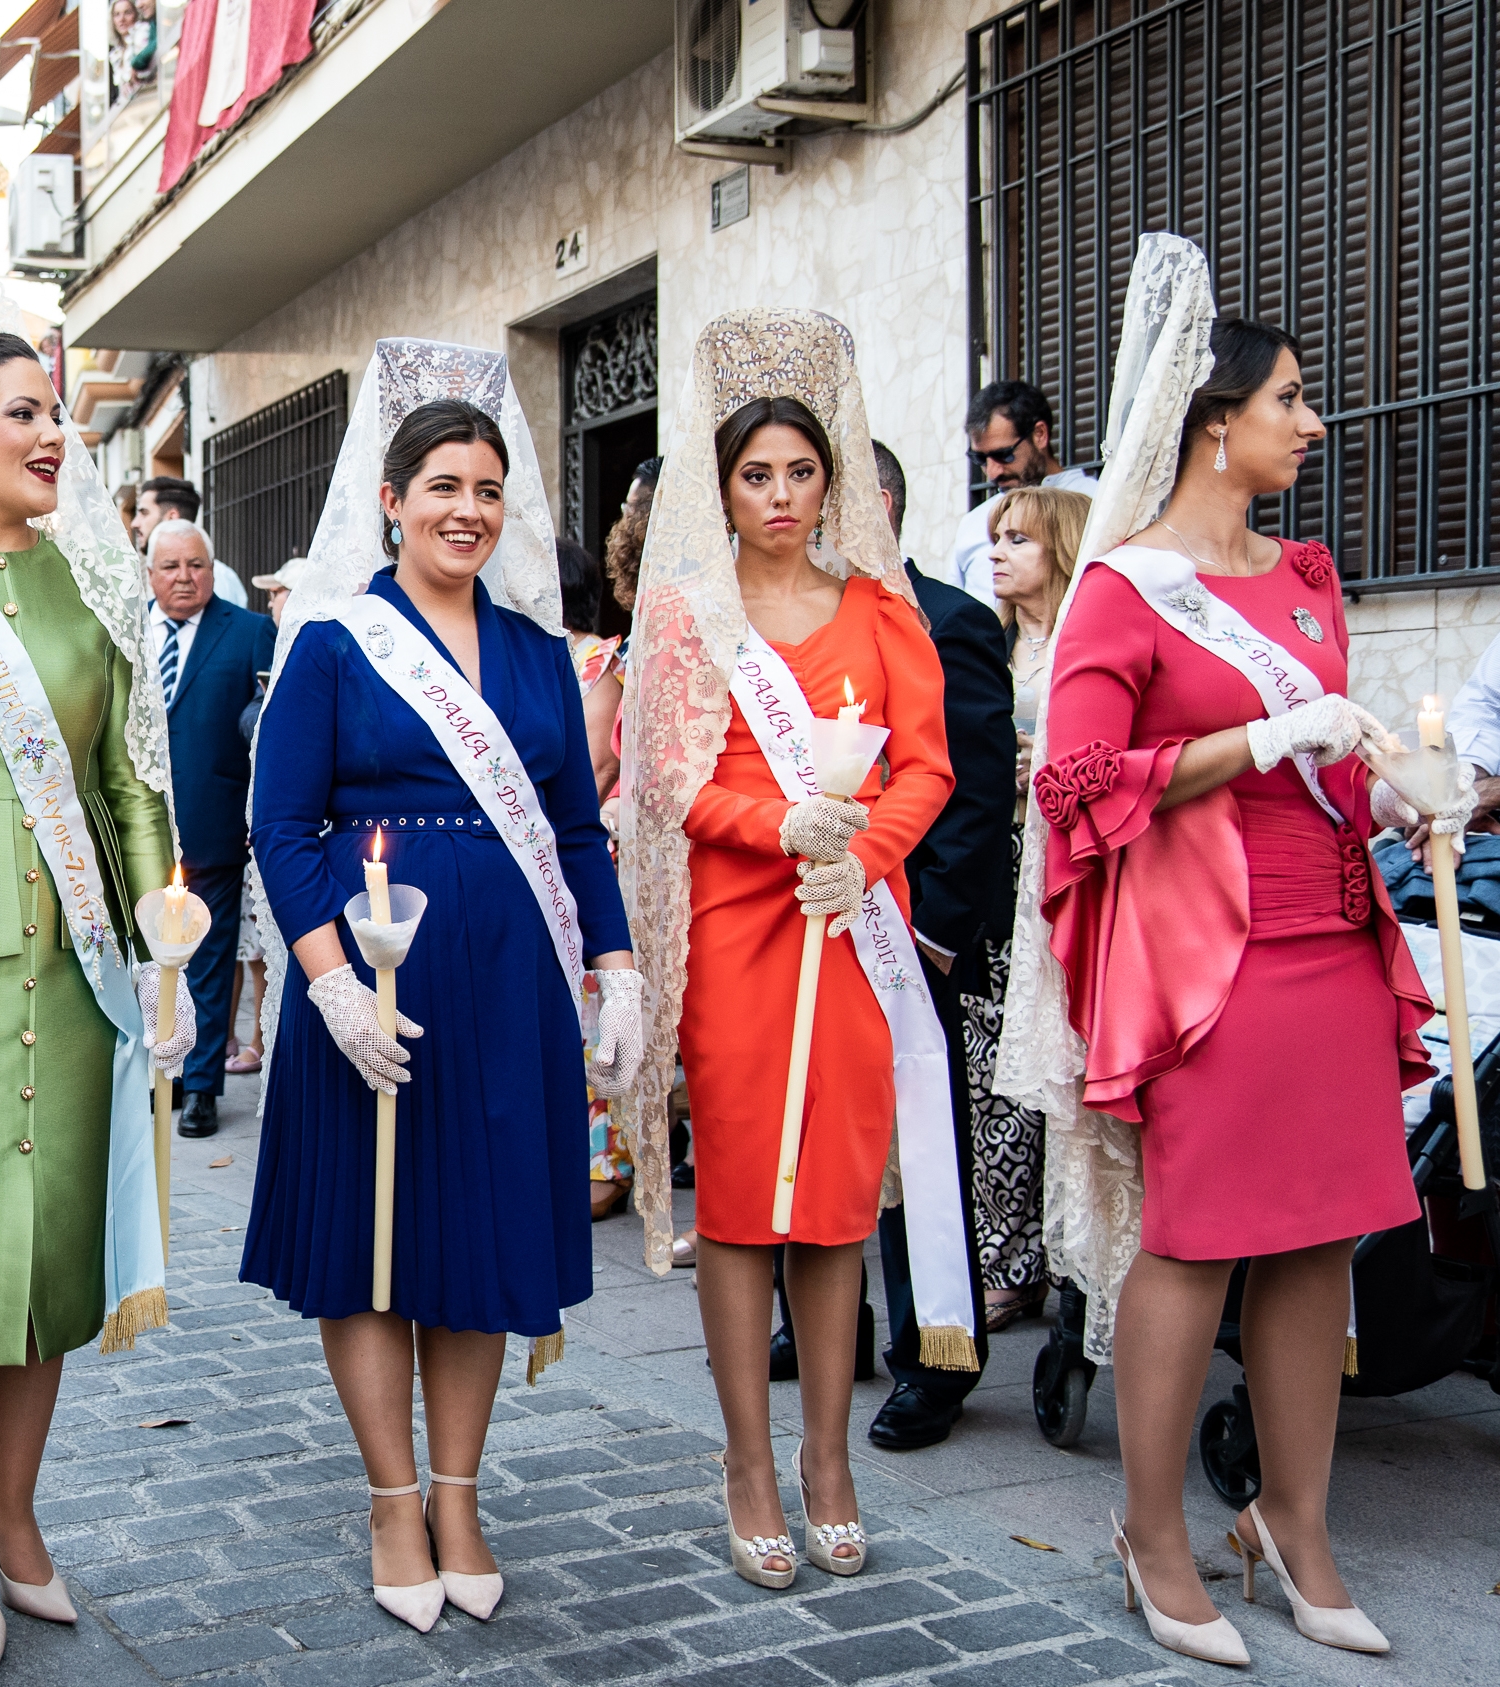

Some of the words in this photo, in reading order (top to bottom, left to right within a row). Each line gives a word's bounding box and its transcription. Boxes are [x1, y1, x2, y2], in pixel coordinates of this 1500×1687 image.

[555, 231, 580, 269] 24
[1248, 649, 1308, 711] DAM
[422, 685, 491, 760] DAMA
[496, 785, 527, 825] DE
[532, 849, 580, 976] HONOR-2017
[737, 661, 795, 739] DAMA
[861, 889, 898, 965] OR-2017
